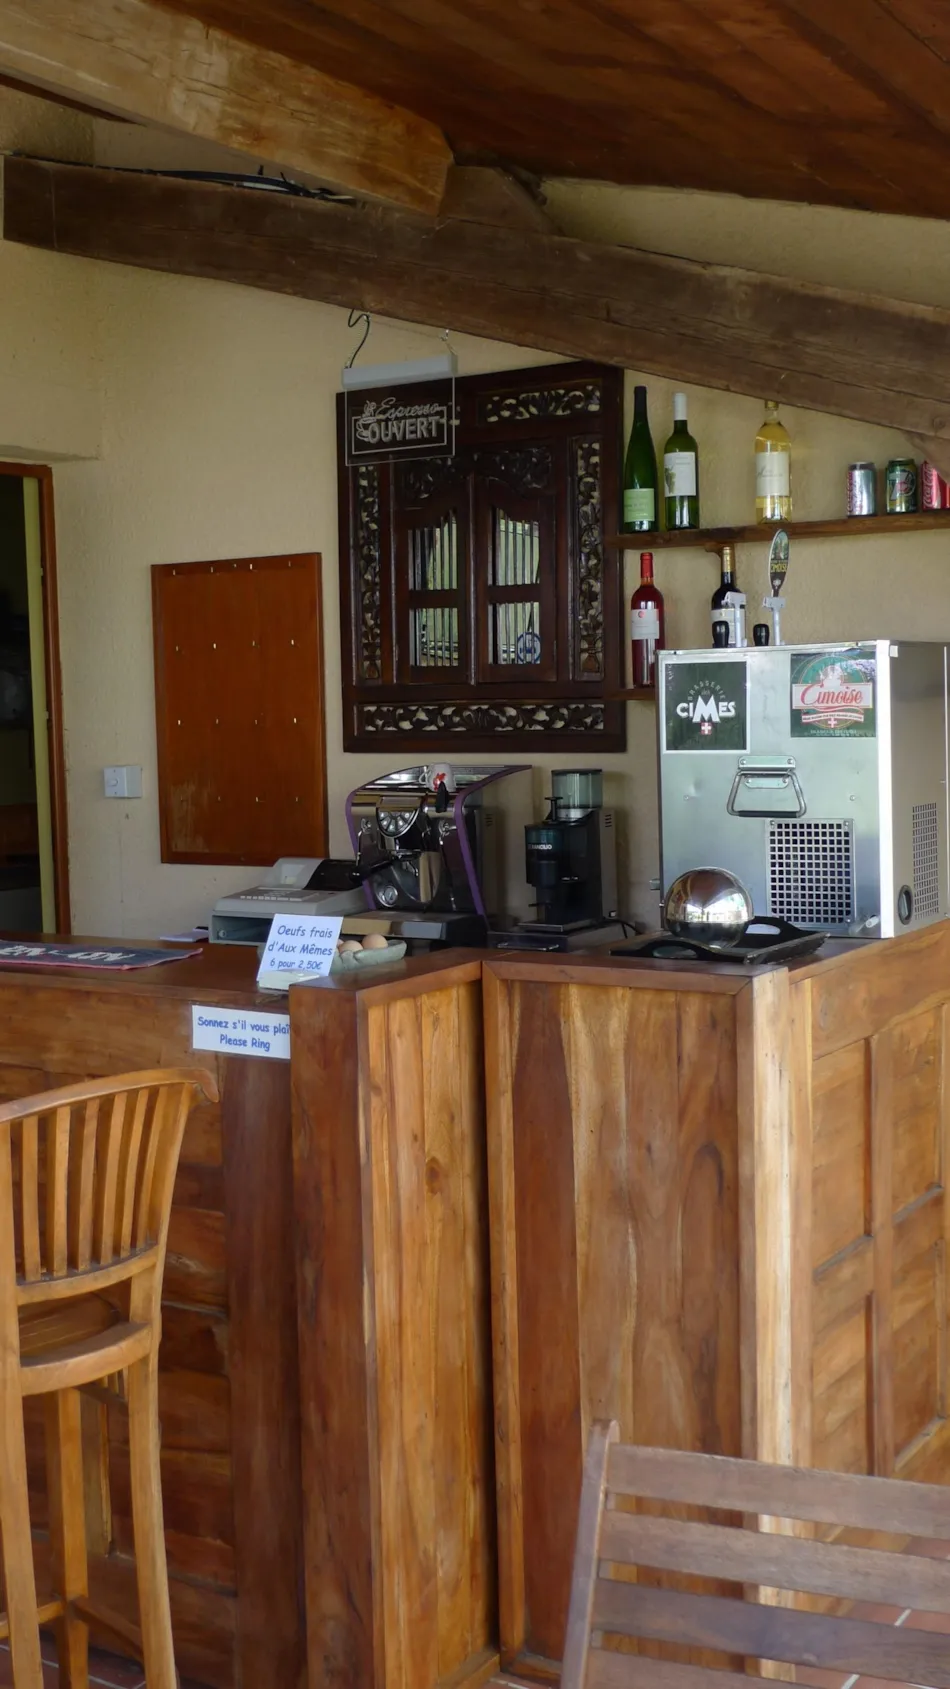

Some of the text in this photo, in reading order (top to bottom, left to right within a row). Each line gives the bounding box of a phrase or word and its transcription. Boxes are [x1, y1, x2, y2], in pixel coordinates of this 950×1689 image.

[375, 397, 441, 420] Espresso
[368, 416, 441, 444] OUVERT
[687, 680, 726, 701] BRASSERIE
[800, 682, 864, 706] Cimoise
[676, 694, 737, 723] CIMES
[277, 924, 333, 939] Oeufs frais
[268, 941, 333, 956] d'Aux Mêmes
[270, 958, 324, 970] 6 pour 2,50€
[197, 1016, 229, 1029] Sonnez
[232, 1019, 247, 1030] s'il
[250, 1023, 270, 1033] vous
[219, 1033, 271, 1052] Please Ring
